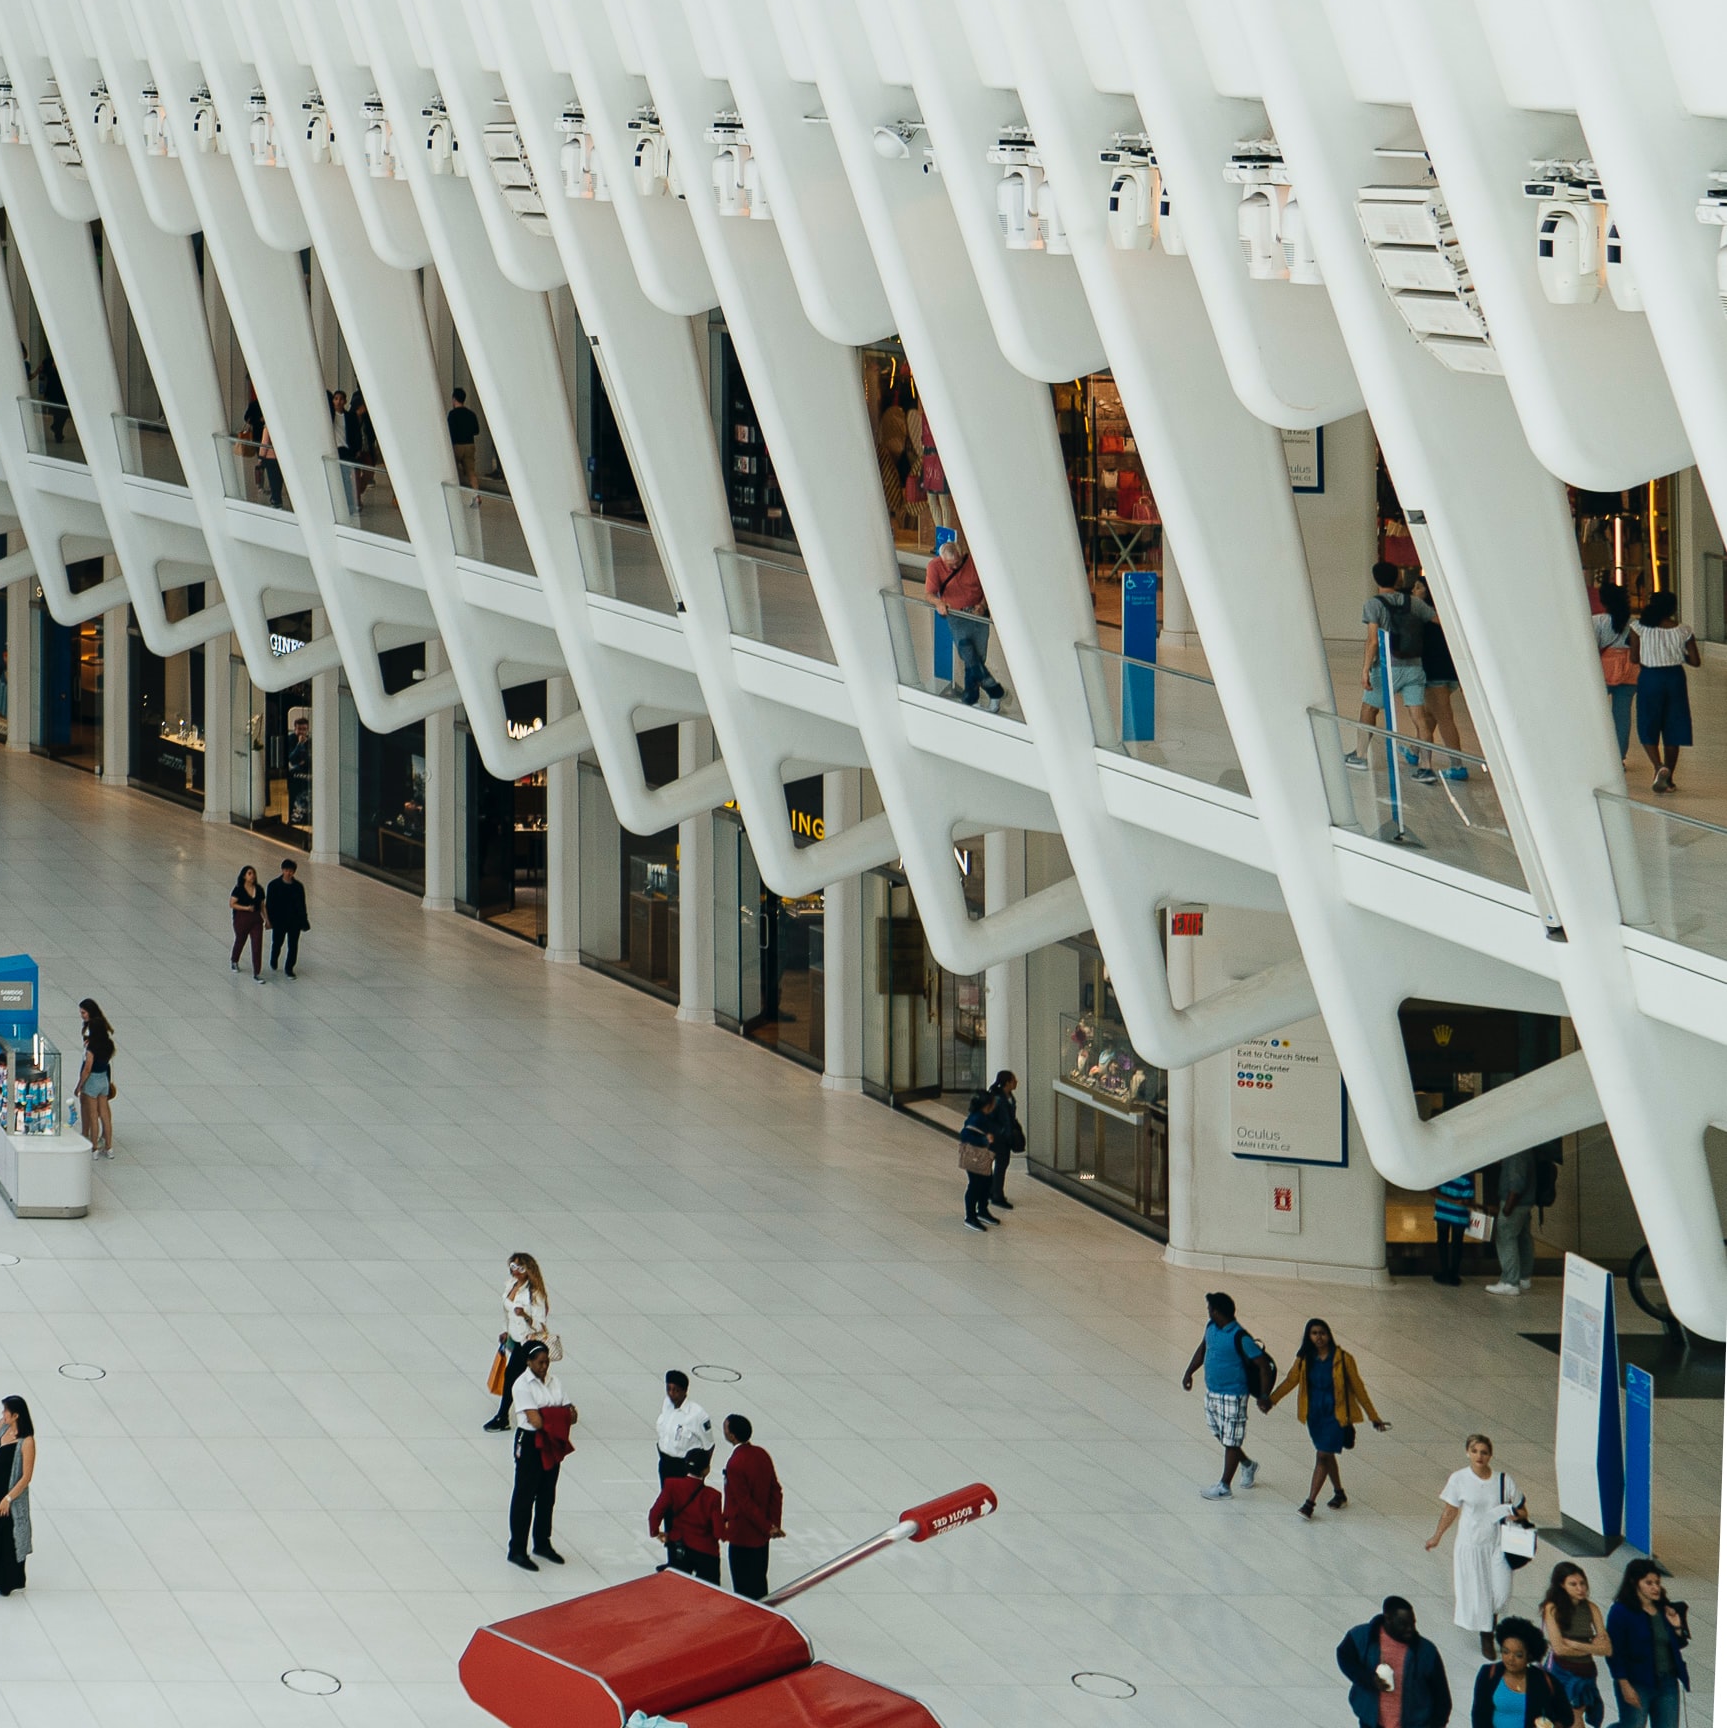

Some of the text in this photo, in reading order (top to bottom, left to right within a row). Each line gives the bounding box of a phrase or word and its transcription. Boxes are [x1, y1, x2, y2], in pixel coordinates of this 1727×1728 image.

[1174, 912, 1202, 936] EXIT
[1236, 1049, 1252, 1057] Exit
[1263, 1051, 1293, 1061] Church
[1294, 1054, 1319, 1063] Street
[1237, 1062, 1290, 1073] Fulton Center
[1237, 1127, 1281, 1142] Oculus
[1237, 1141, 1256, 1149] MAIN
[1257, 1143, 1279, 1151] LEVEL
